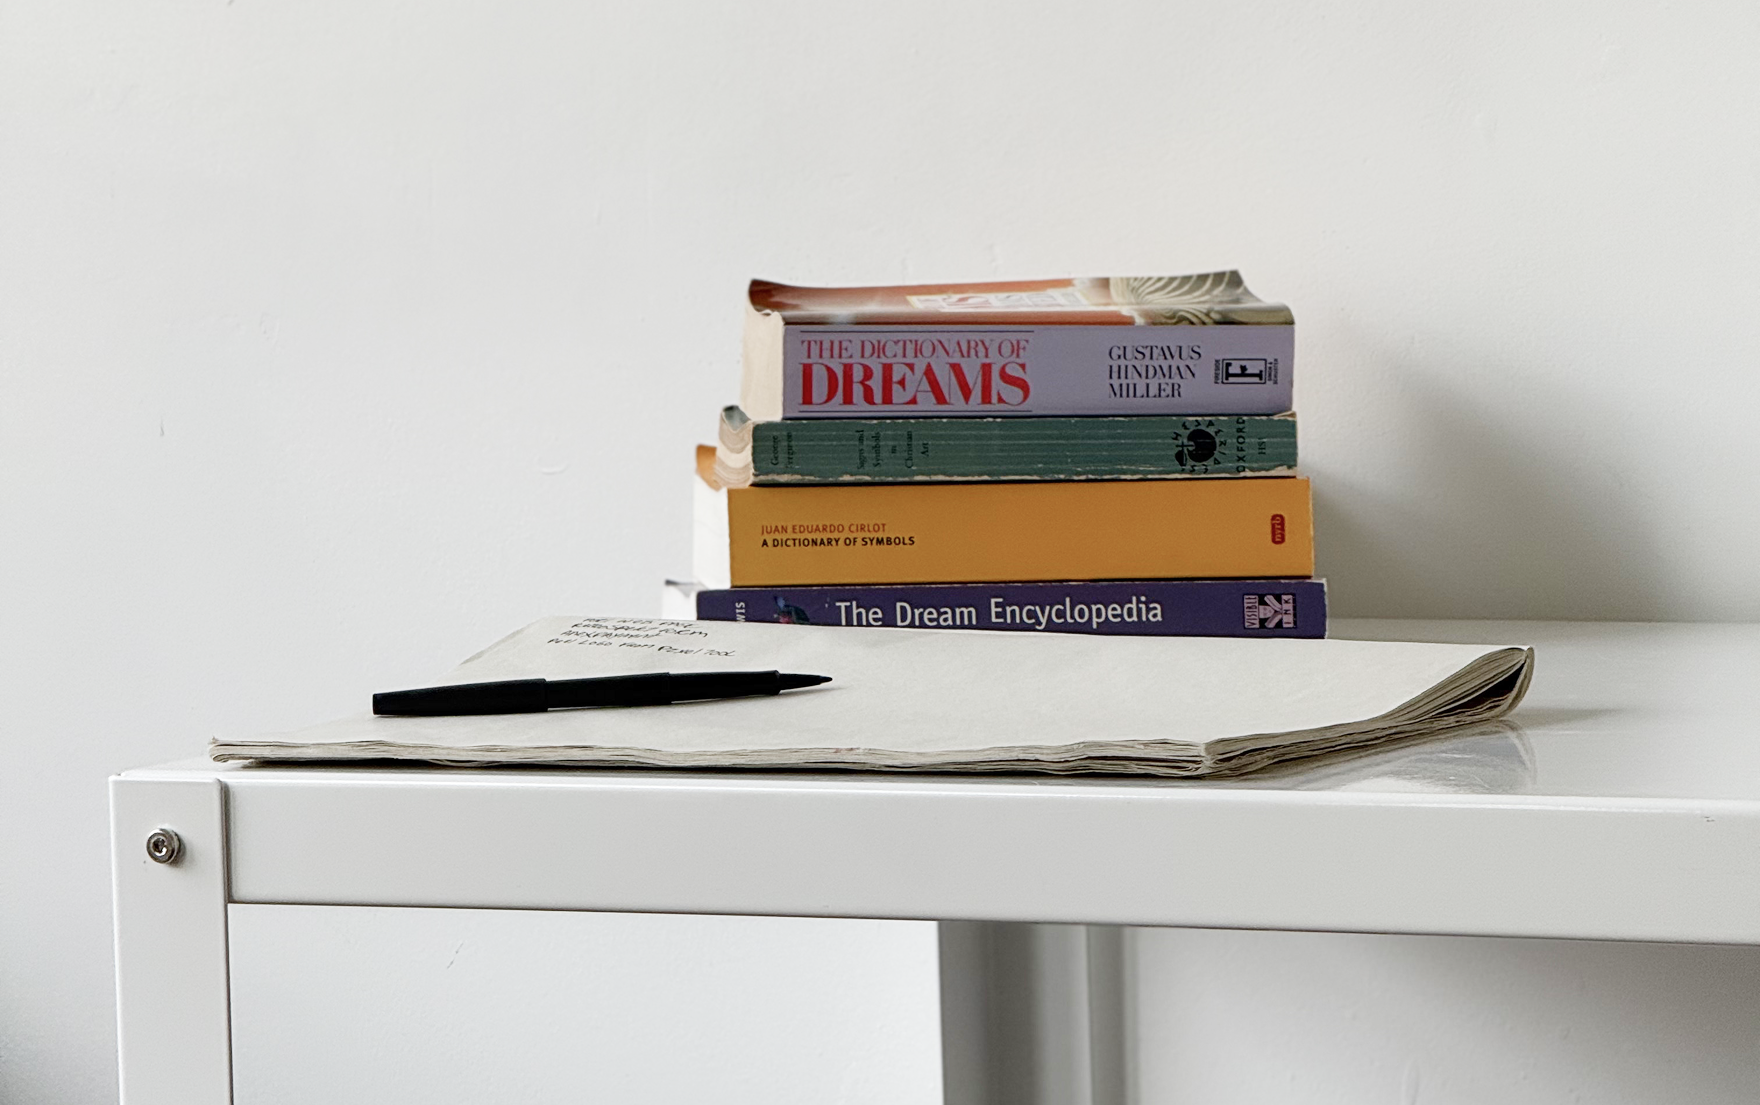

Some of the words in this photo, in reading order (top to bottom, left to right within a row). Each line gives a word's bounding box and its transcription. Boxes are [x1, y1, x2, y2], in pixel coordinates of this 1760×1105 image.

[801, 339, 853, 359] THE
[860, 339, 993, 359] DICTIONARY
[997, 339, 1030, 359] OF
[1108, 345, 1202, 361] GUSTAVUS
[798, 361, 1031, 406] DREAMS
[1108, 364, 1197, 380] HINDMAN
[1108, 383, 1182, 398] MILLER
[871, 431, 883, 467] Symbols
[920, 442, 929, 457] Art
[1236, 417, 1246, 473] OXFORD
[761, 524, 788, 535] JUAN
[792, 524, 845, 534] EDUARDO
[848, 523, 887, 533] CIRLOT
[1272, 516, 1284, 542] nyrb
[761, 538, 769, 548] A
[772, 537, 840, 547] DICTIONARY
[844, 537, 858, 546] OF
[861, 536, 915, 546] SYMBOLS
[835, 601, 883, 626] The
[896, 601, 977, 627] Dream
[990, 596, 1163, 629] Encyclopedia
[1245, 596, 1258, 628] VISIBLE
[1283, 597, 1292, 625] INK
